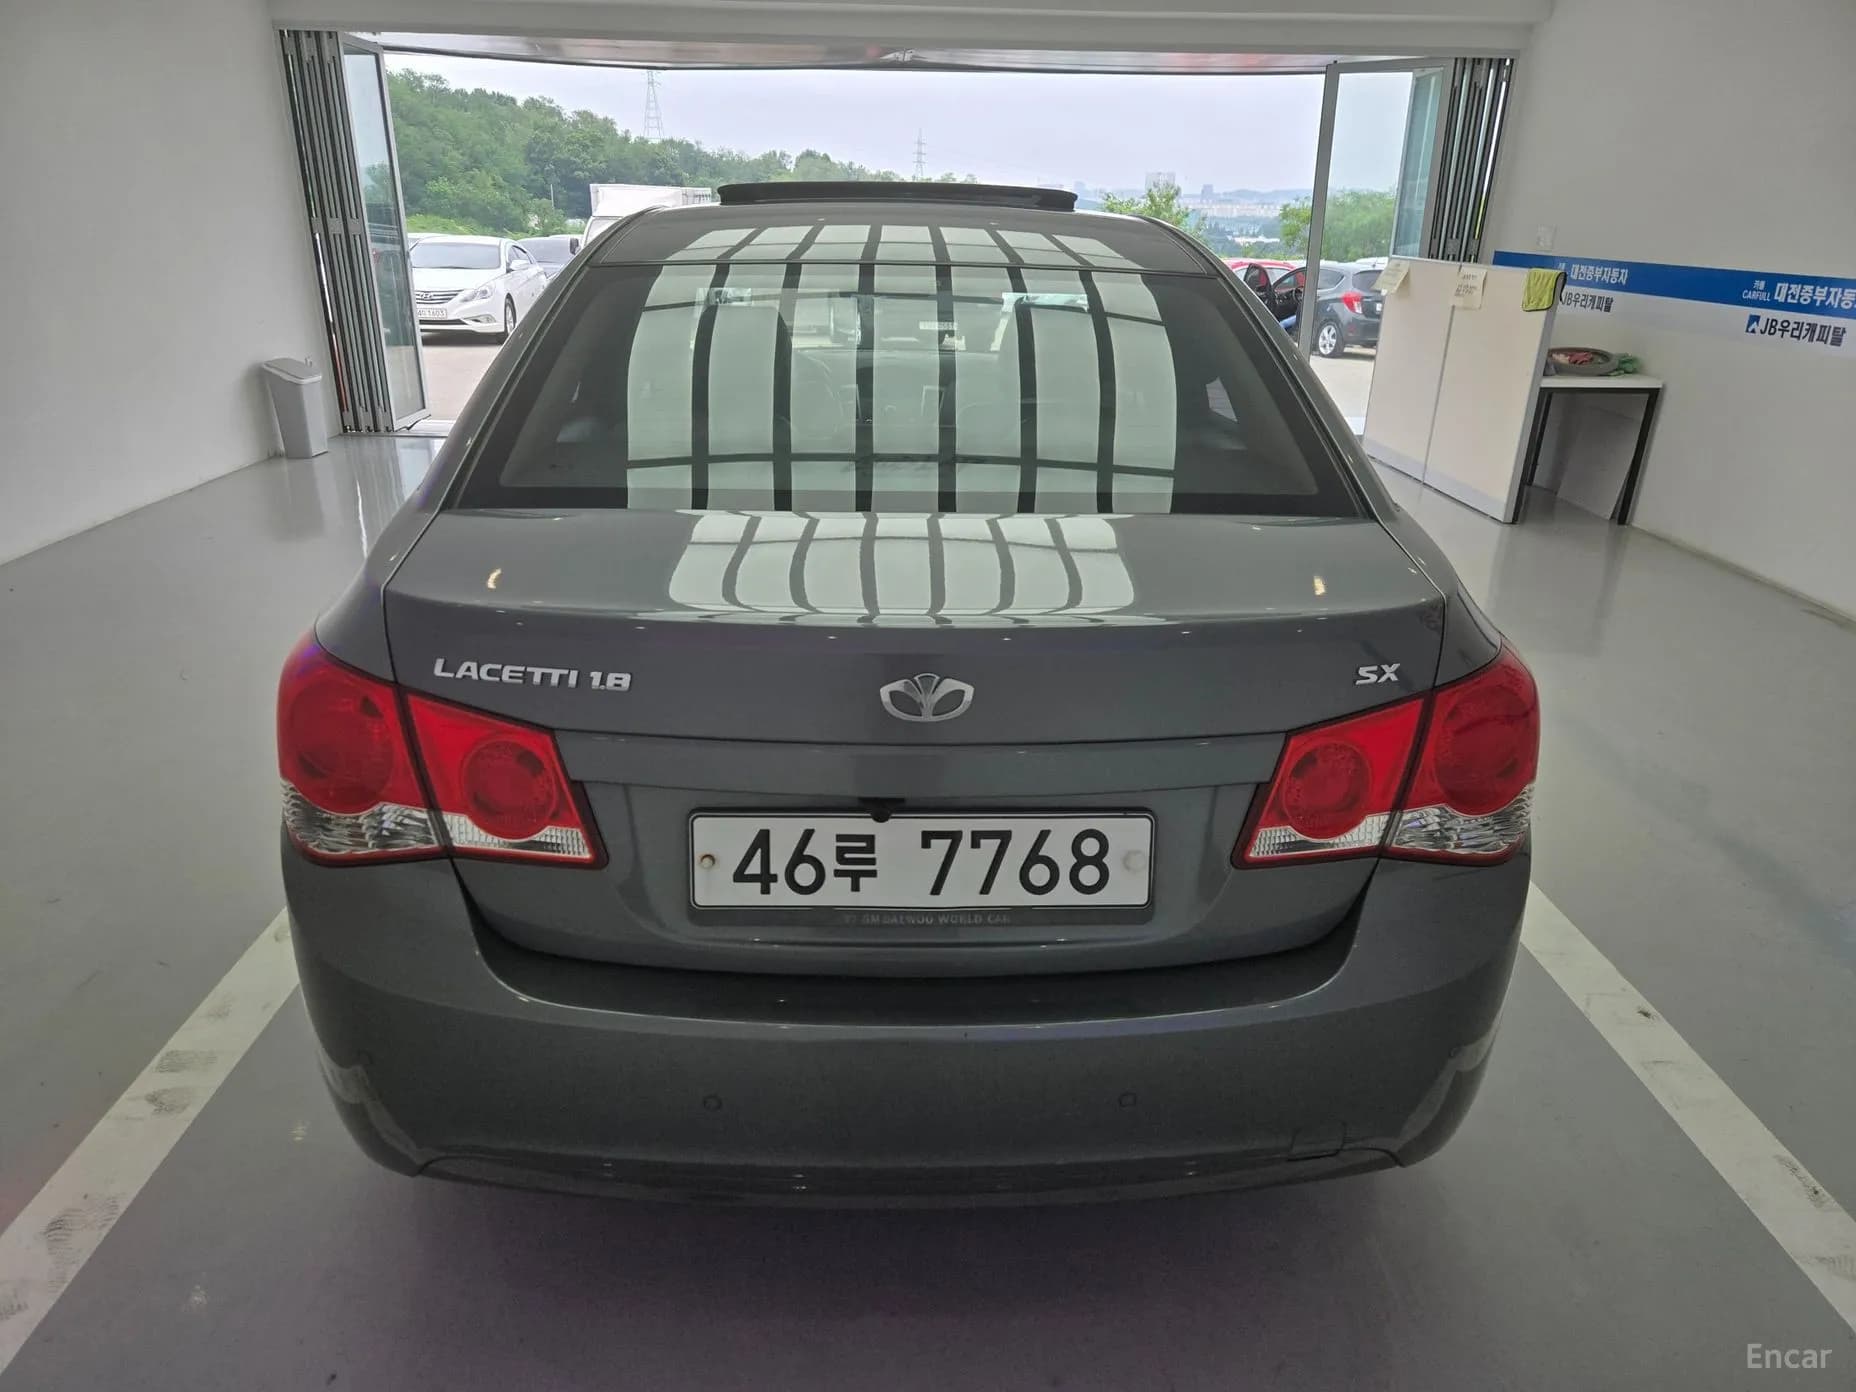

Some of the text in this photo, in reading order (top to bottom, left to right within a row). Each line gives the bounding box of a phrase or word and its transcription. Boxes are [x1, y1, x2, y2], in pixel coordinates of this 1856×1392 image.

[1570, 264, 1629, 285] 대전중부자동차
[1774, 282, 1856, 309] 대전중부자동
[1760, 318, 1846, 346] JB우리캐피탈
[434, 658, 632, 691] LACETTI 1.8
[1355, 663, 1400, 685] SX
[732, 828, 1110, 896] 46루 7768
